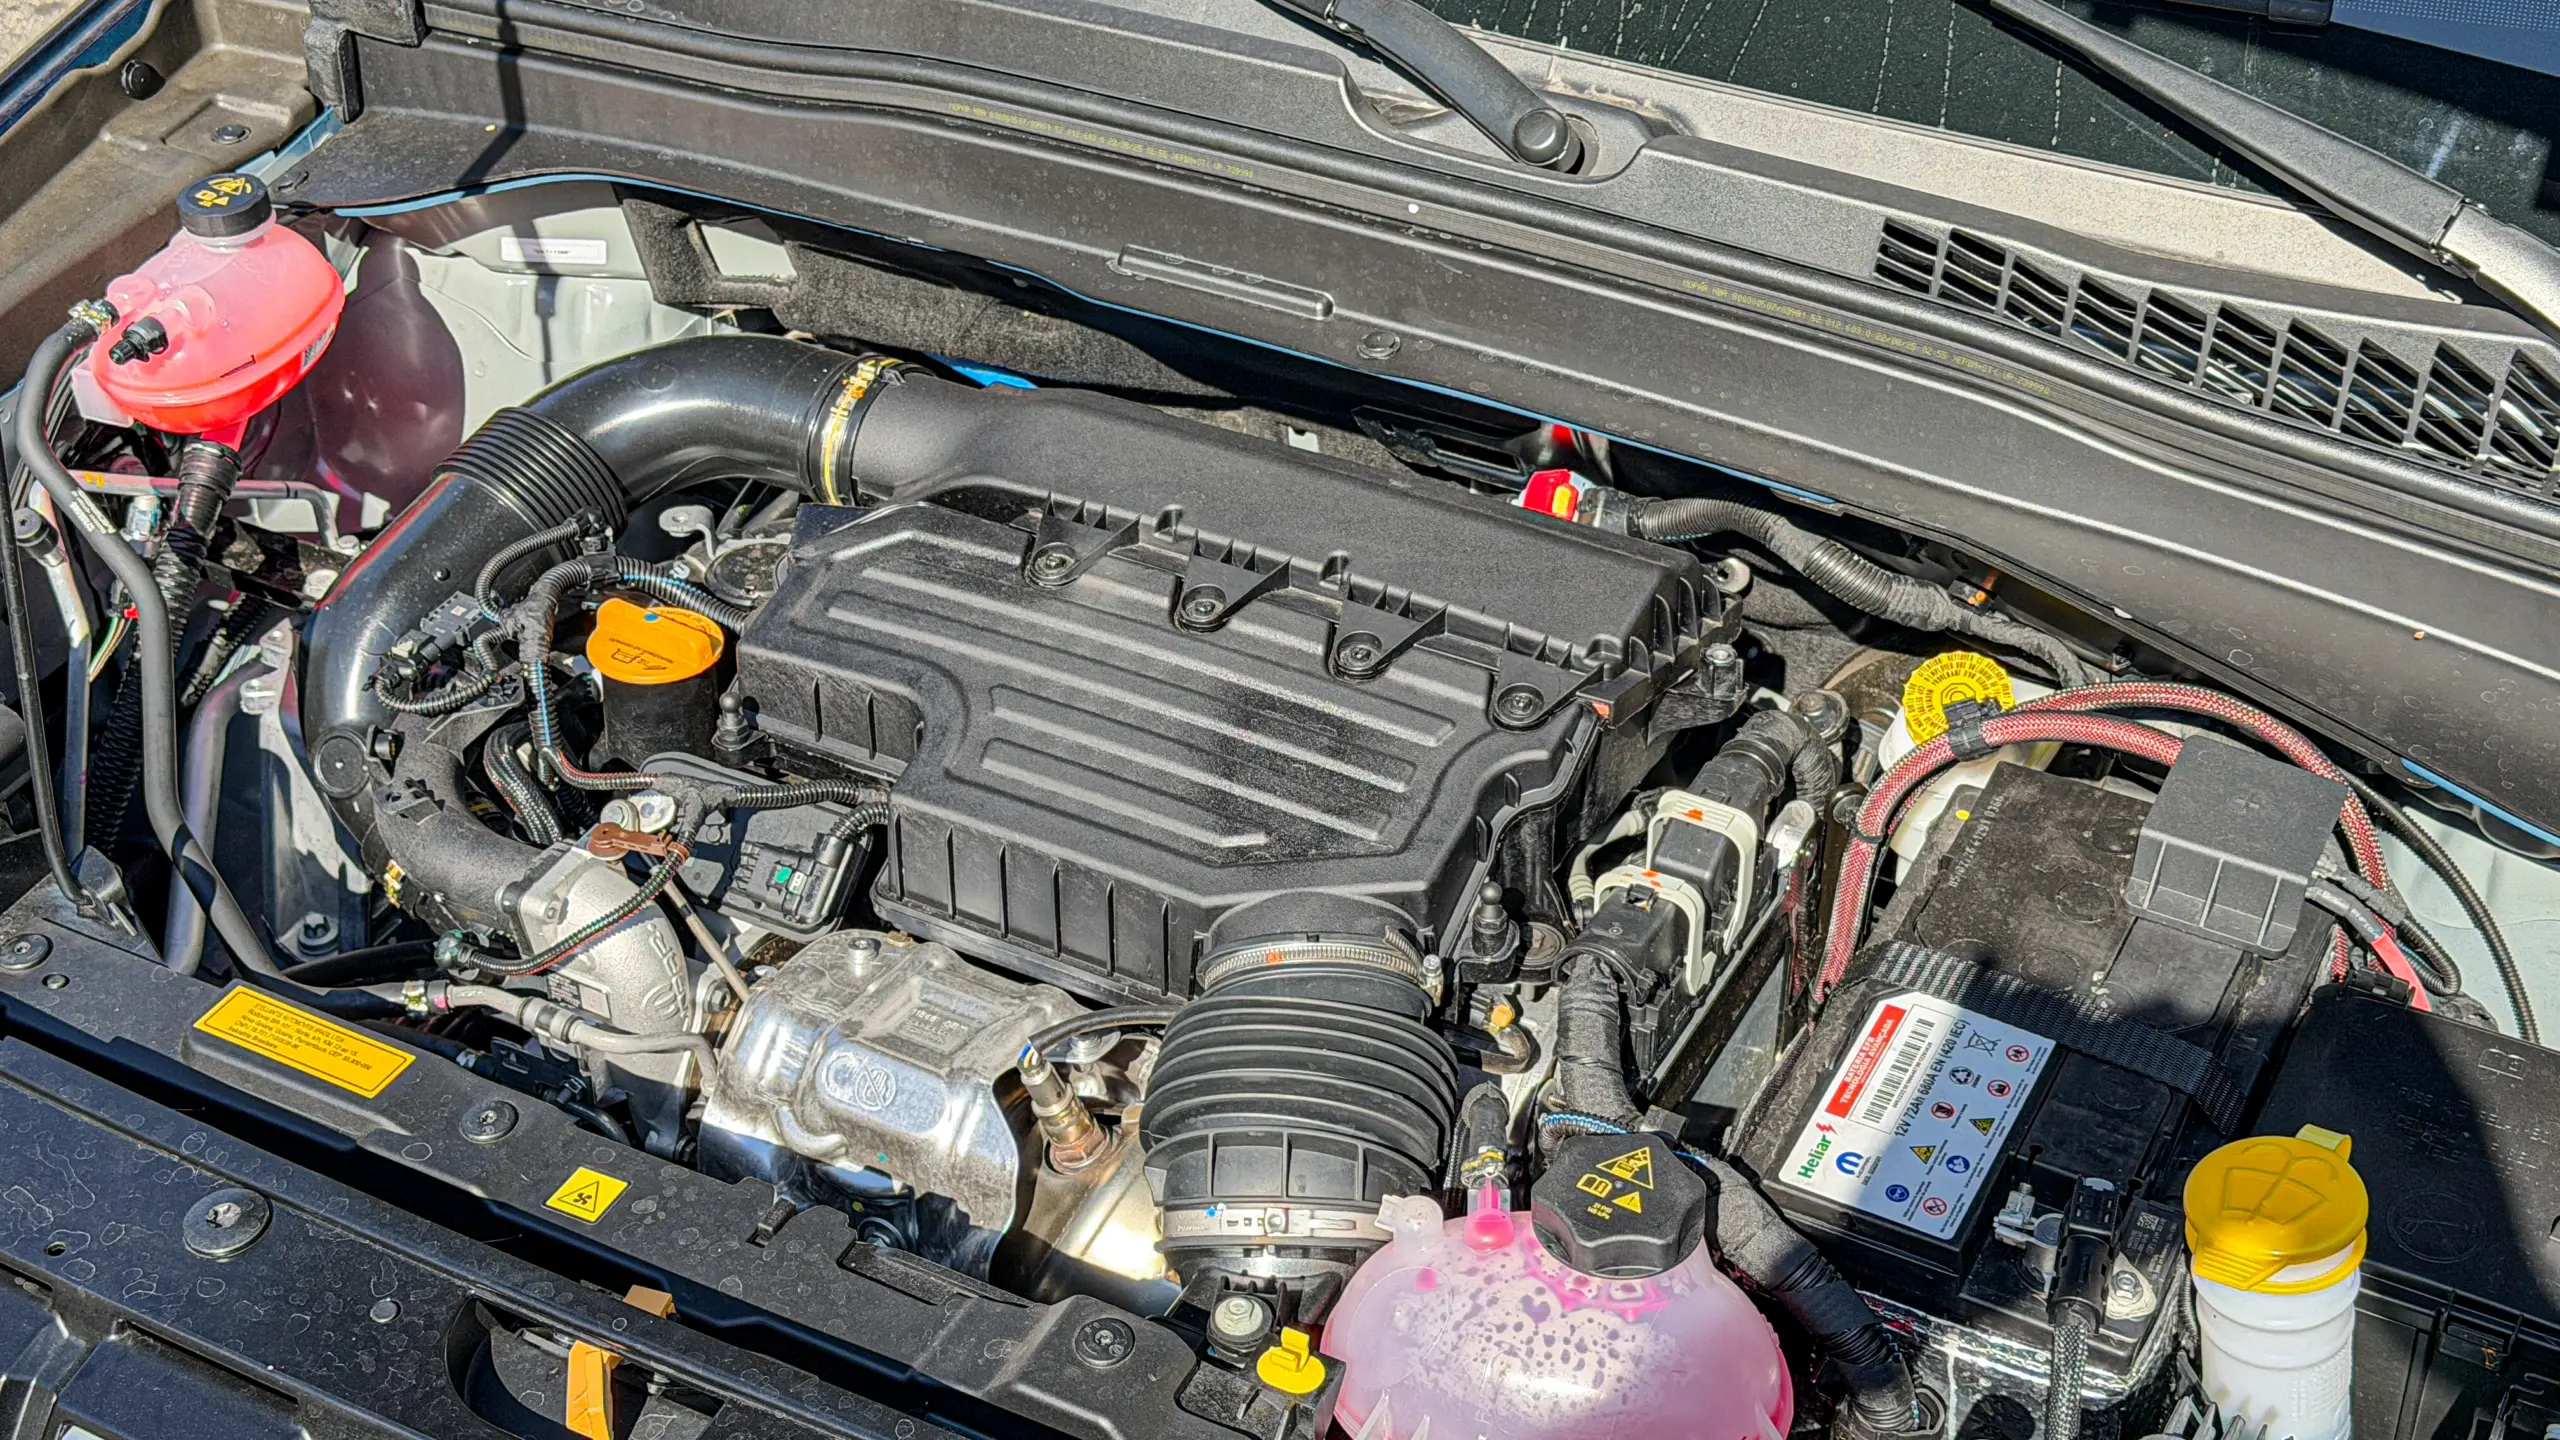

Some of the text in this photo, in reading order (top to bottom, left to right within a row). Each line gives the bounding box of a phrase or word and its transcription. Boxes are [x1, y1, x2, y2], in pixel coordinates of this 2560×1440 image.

[1948, 1018, 1971, 1038] IEC)
[1839, 1056, 1872, 1104] TECNOLOGIA
[1866, 1017, 1896, 1057] AVANÇADA
[1843, 1050, 1867, 1082] BATERIA
[1861, 1035, 1875, 1051] EFB
[1936, 1038, 1960, 1059] (420
[1929, 1058, 1946, 1072] EN
[1917, 1071, 1939, 1095] 680A
[1903, 1095, 1926, 1119] 72Ah
[1893, 1120, 1912, 1138] 12V
[1796, 1133, 1833, 1179] Heliar
